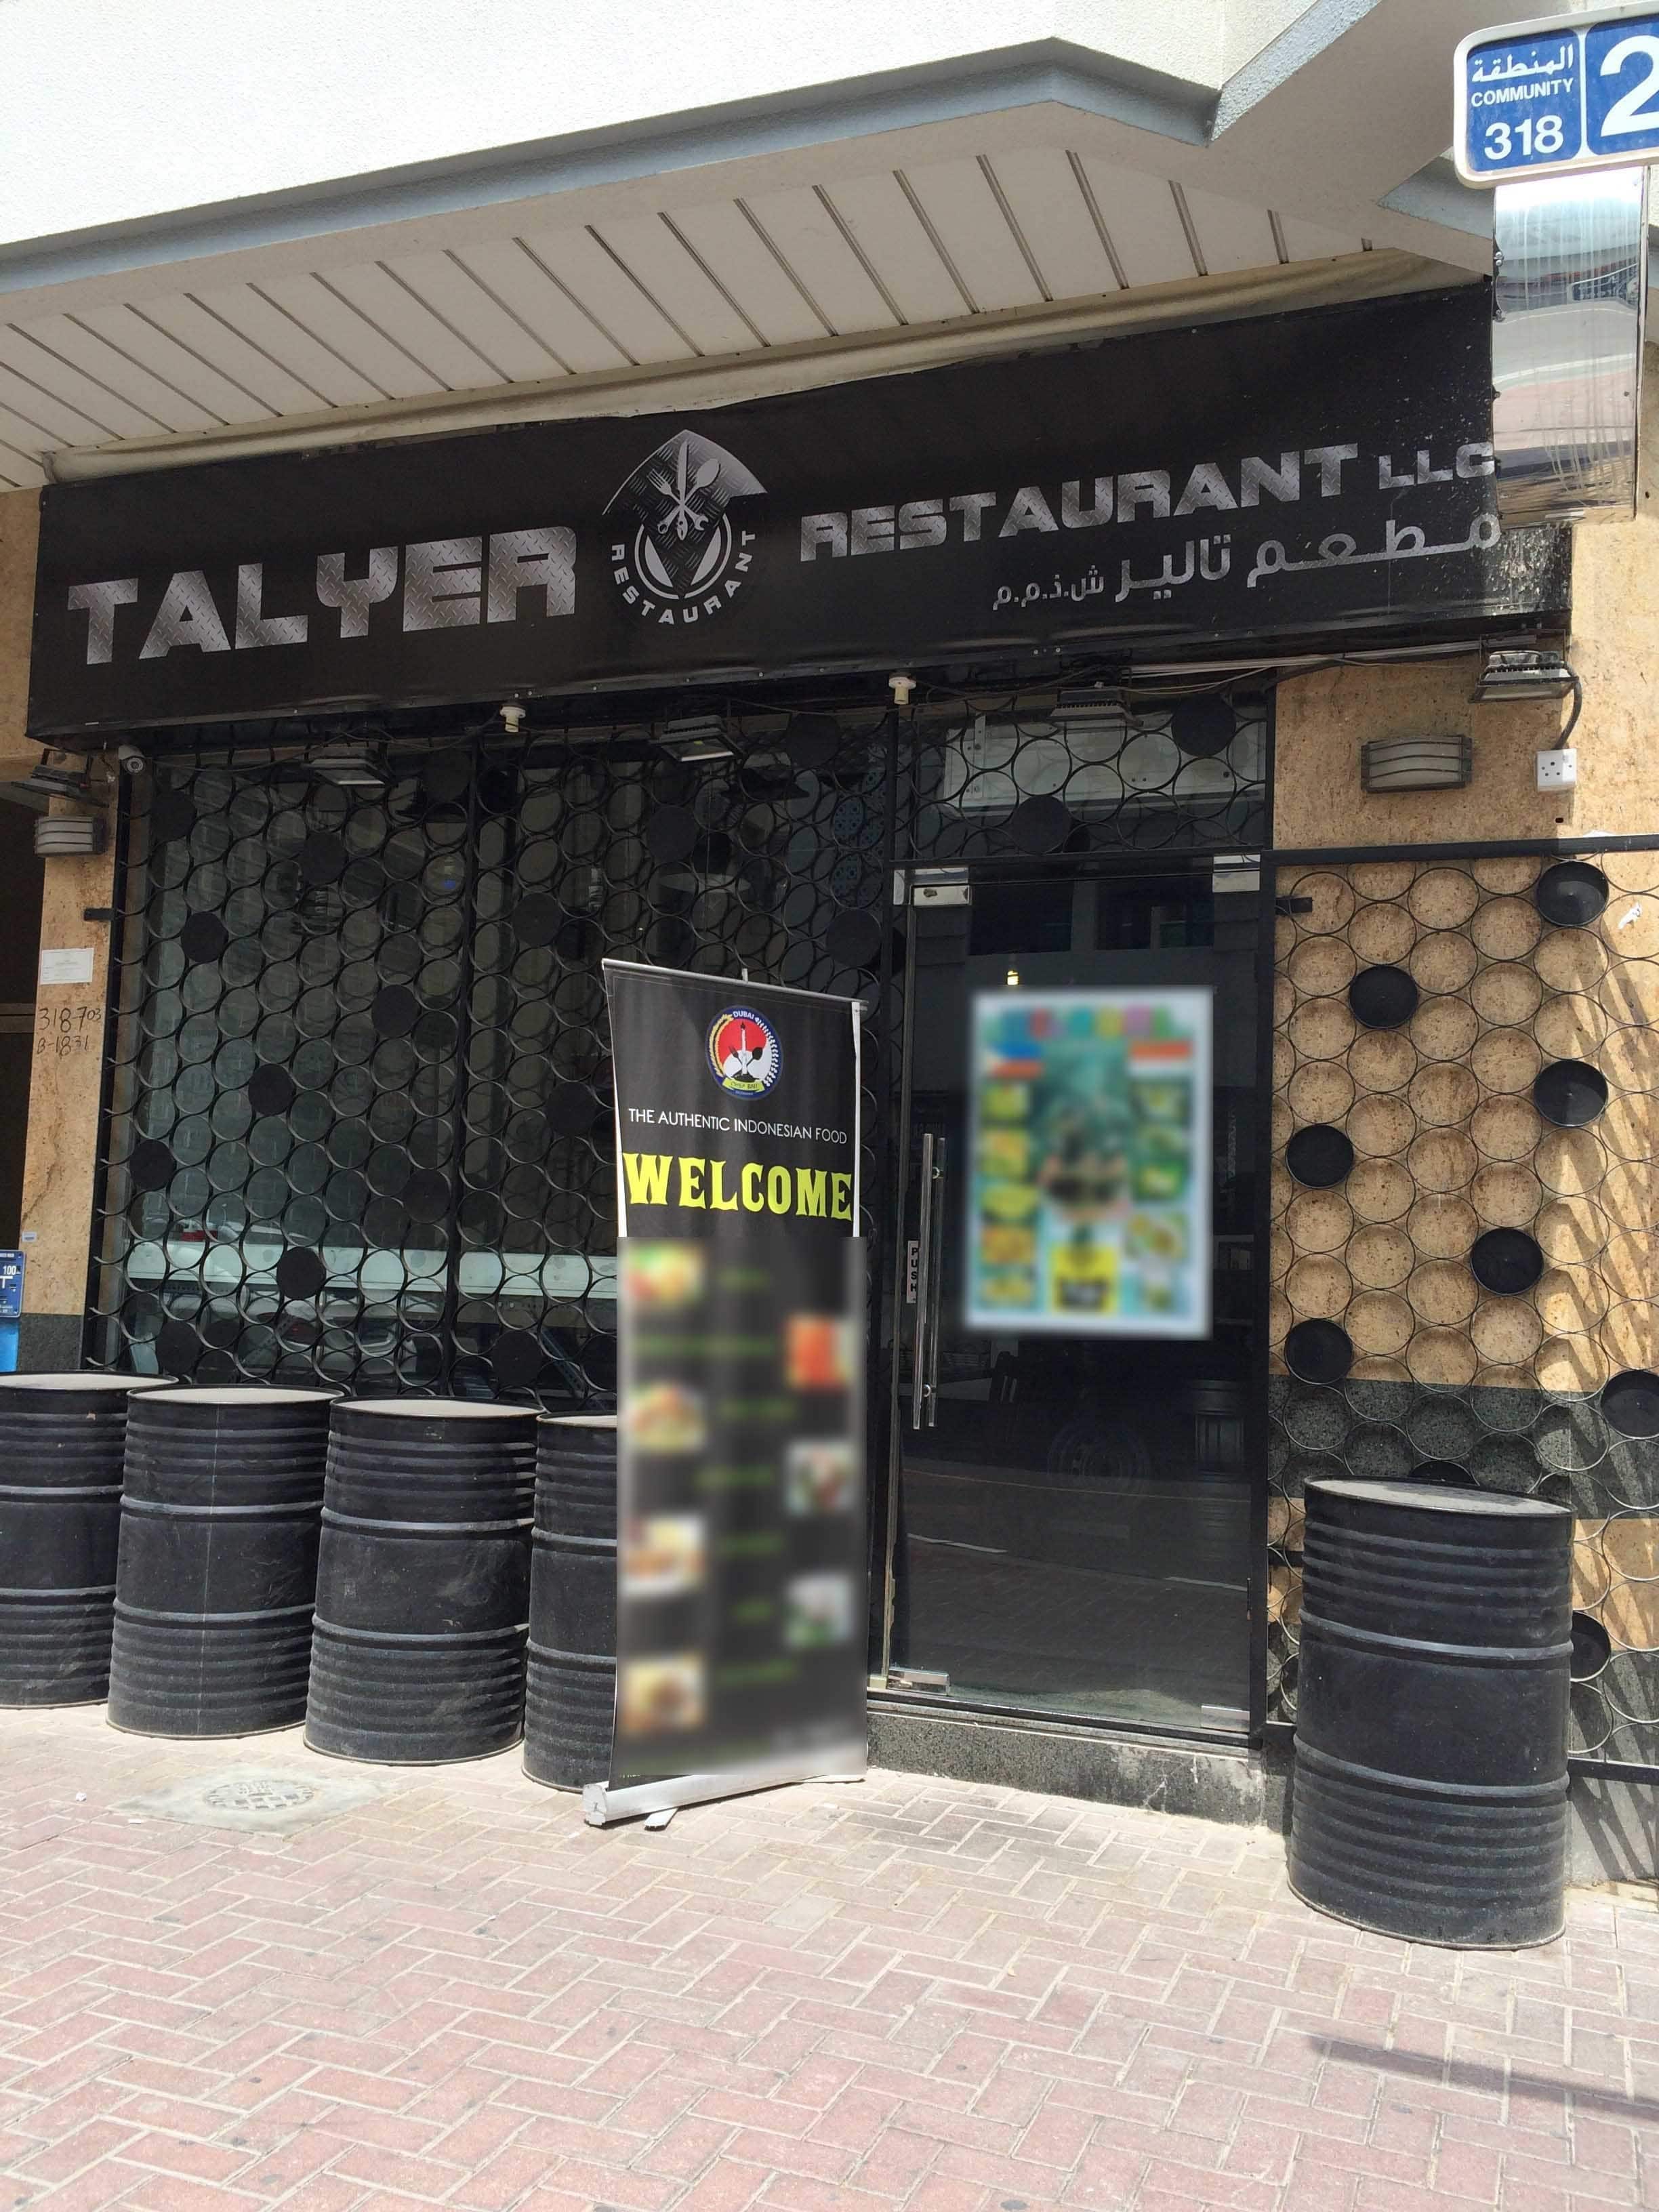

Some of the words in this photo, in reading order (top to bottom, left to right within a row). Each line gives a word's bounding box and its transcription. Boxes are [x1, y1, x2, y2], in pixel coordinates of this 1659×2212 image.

[1471, 43, 1574, 82] المنطقة
[1471, 77, 1574, 107] COMMUNITY
[1484, 115, 1564, 160] 318
[67, 526, 577, 665] TALYER
[800, 443, 1358, 562] RESTAURANT
[1378, 442, 1495, 490] LLC
[1246, 513, 1500, 588] مطعم
[611, 531, 756, 625] RESTAURANT
[733, 1010, 754, 1020] DUBAI
[628, 1108, 655, 1123] THE
[658, 1111, 730, 1131] AUTHENTIC
[735, 1119, 812, 1139] INDONESIAN
[815, 1127, 847, 1144] FOOD
[623, 1153, 852, 1221] WELCOME
[910, 1247, 918, 1292] PUSH
